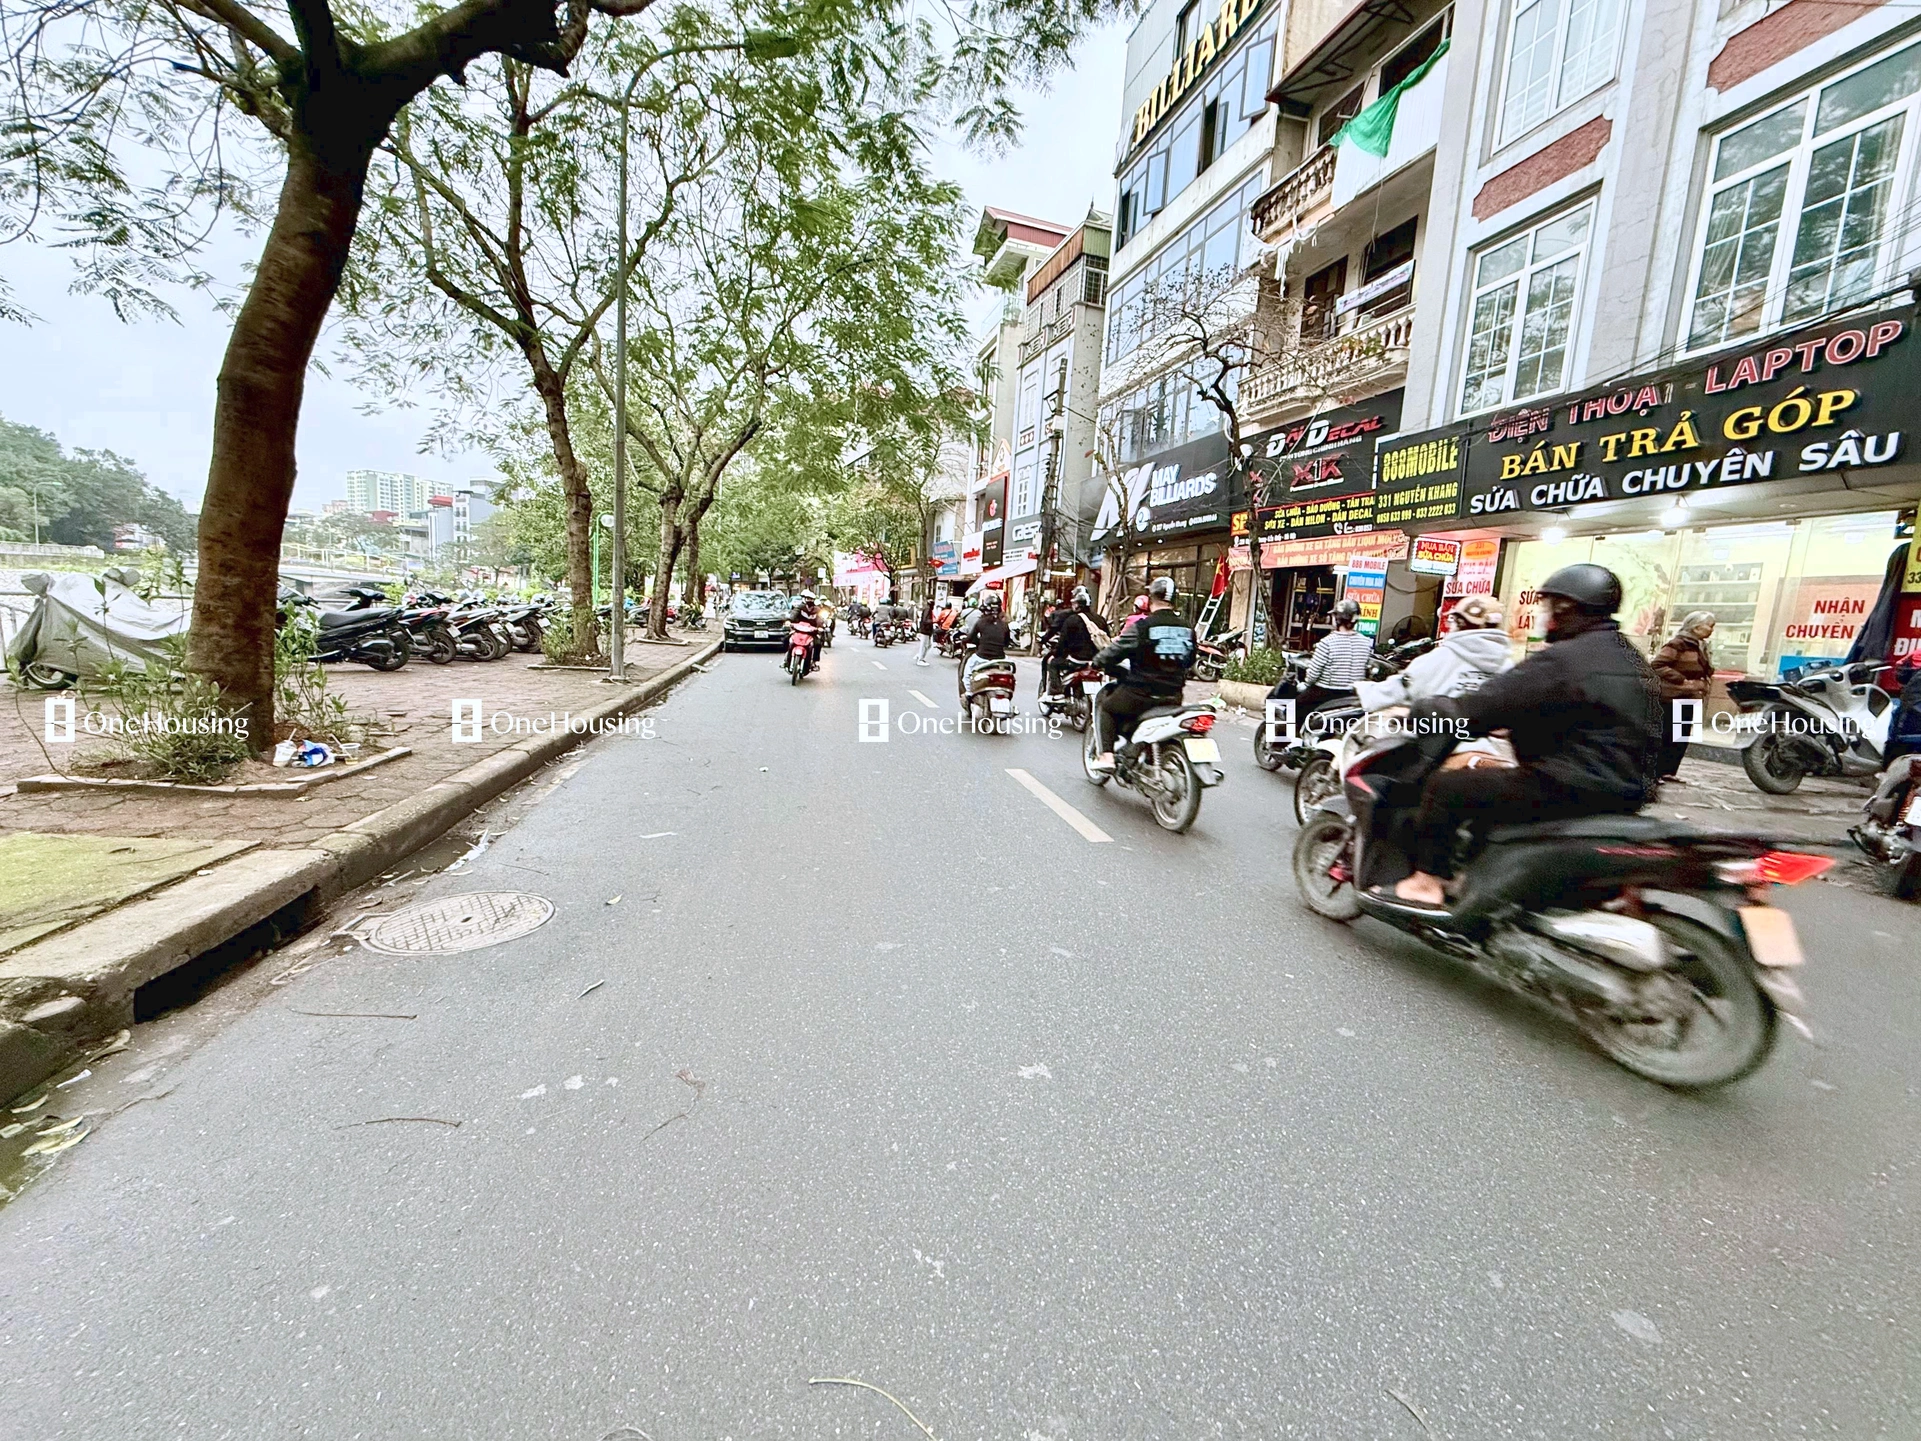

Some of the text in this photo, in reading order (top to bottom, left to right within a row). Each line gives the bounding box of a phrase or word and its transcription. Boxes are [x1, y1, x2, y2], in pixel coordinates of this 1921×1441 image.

[1704, 320, 1903, 394] LAPTOP
[1499, 386, 1857, 480] BÁN TRẢ GÓP
[1470, 429, 1900, 514] SỬA CHỮA CHUYÊN SÂU
[1149, 463, 1217, 508] MAY BILLIARDS
[1378, 494, 1391, 508] 331
[1428, 482, 1458, 500] KHANG
[1361, 496, 1376, 506] TRA
[1348, 508, 1374, 521] DECAL
[1364, 560, 1386, 570] MOBILE
[1813, 596, 1865, 617] NHẬN
